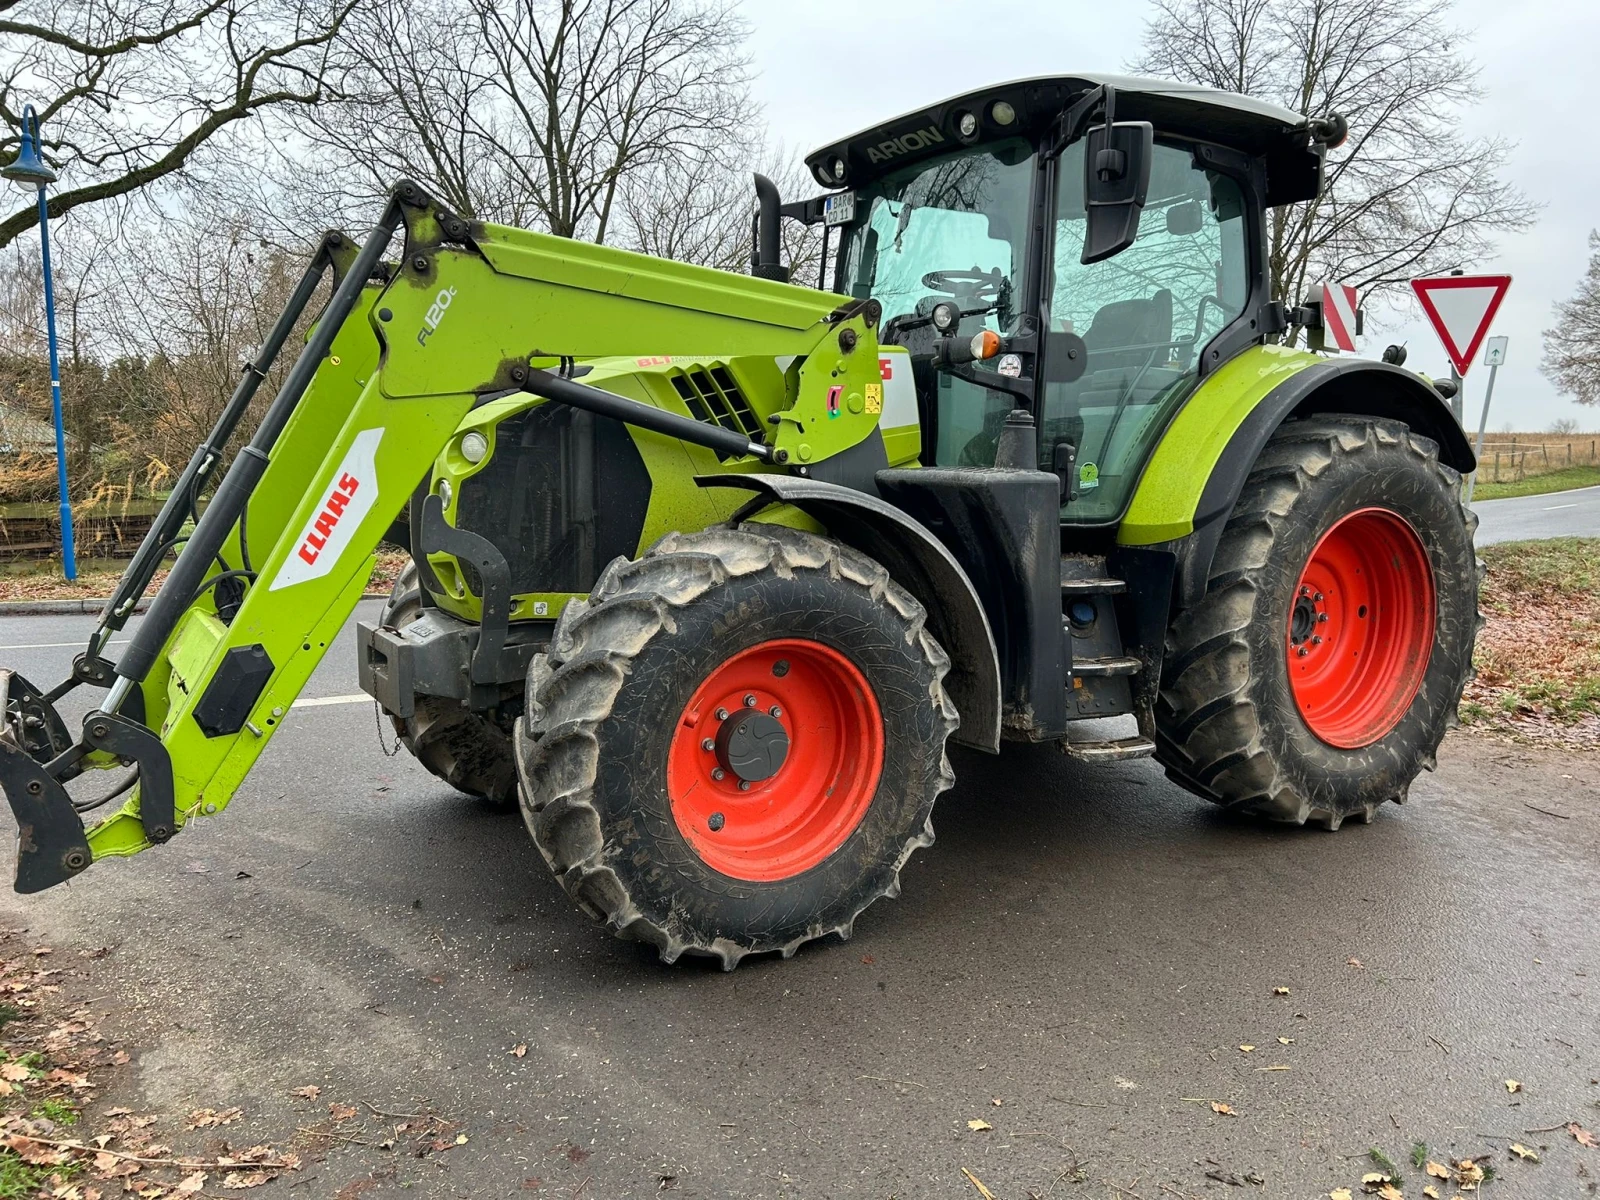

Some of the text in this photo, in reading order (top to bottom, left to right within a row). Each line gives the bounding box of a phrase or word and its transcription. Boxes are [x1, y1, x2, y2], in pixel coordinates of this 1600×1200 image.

[867, 125, 945, 164] ARION
[833, 194, 847, 210] BAR
[839, 207, 849, 221] 11
[298, 472, 360, 566] CLAAS
